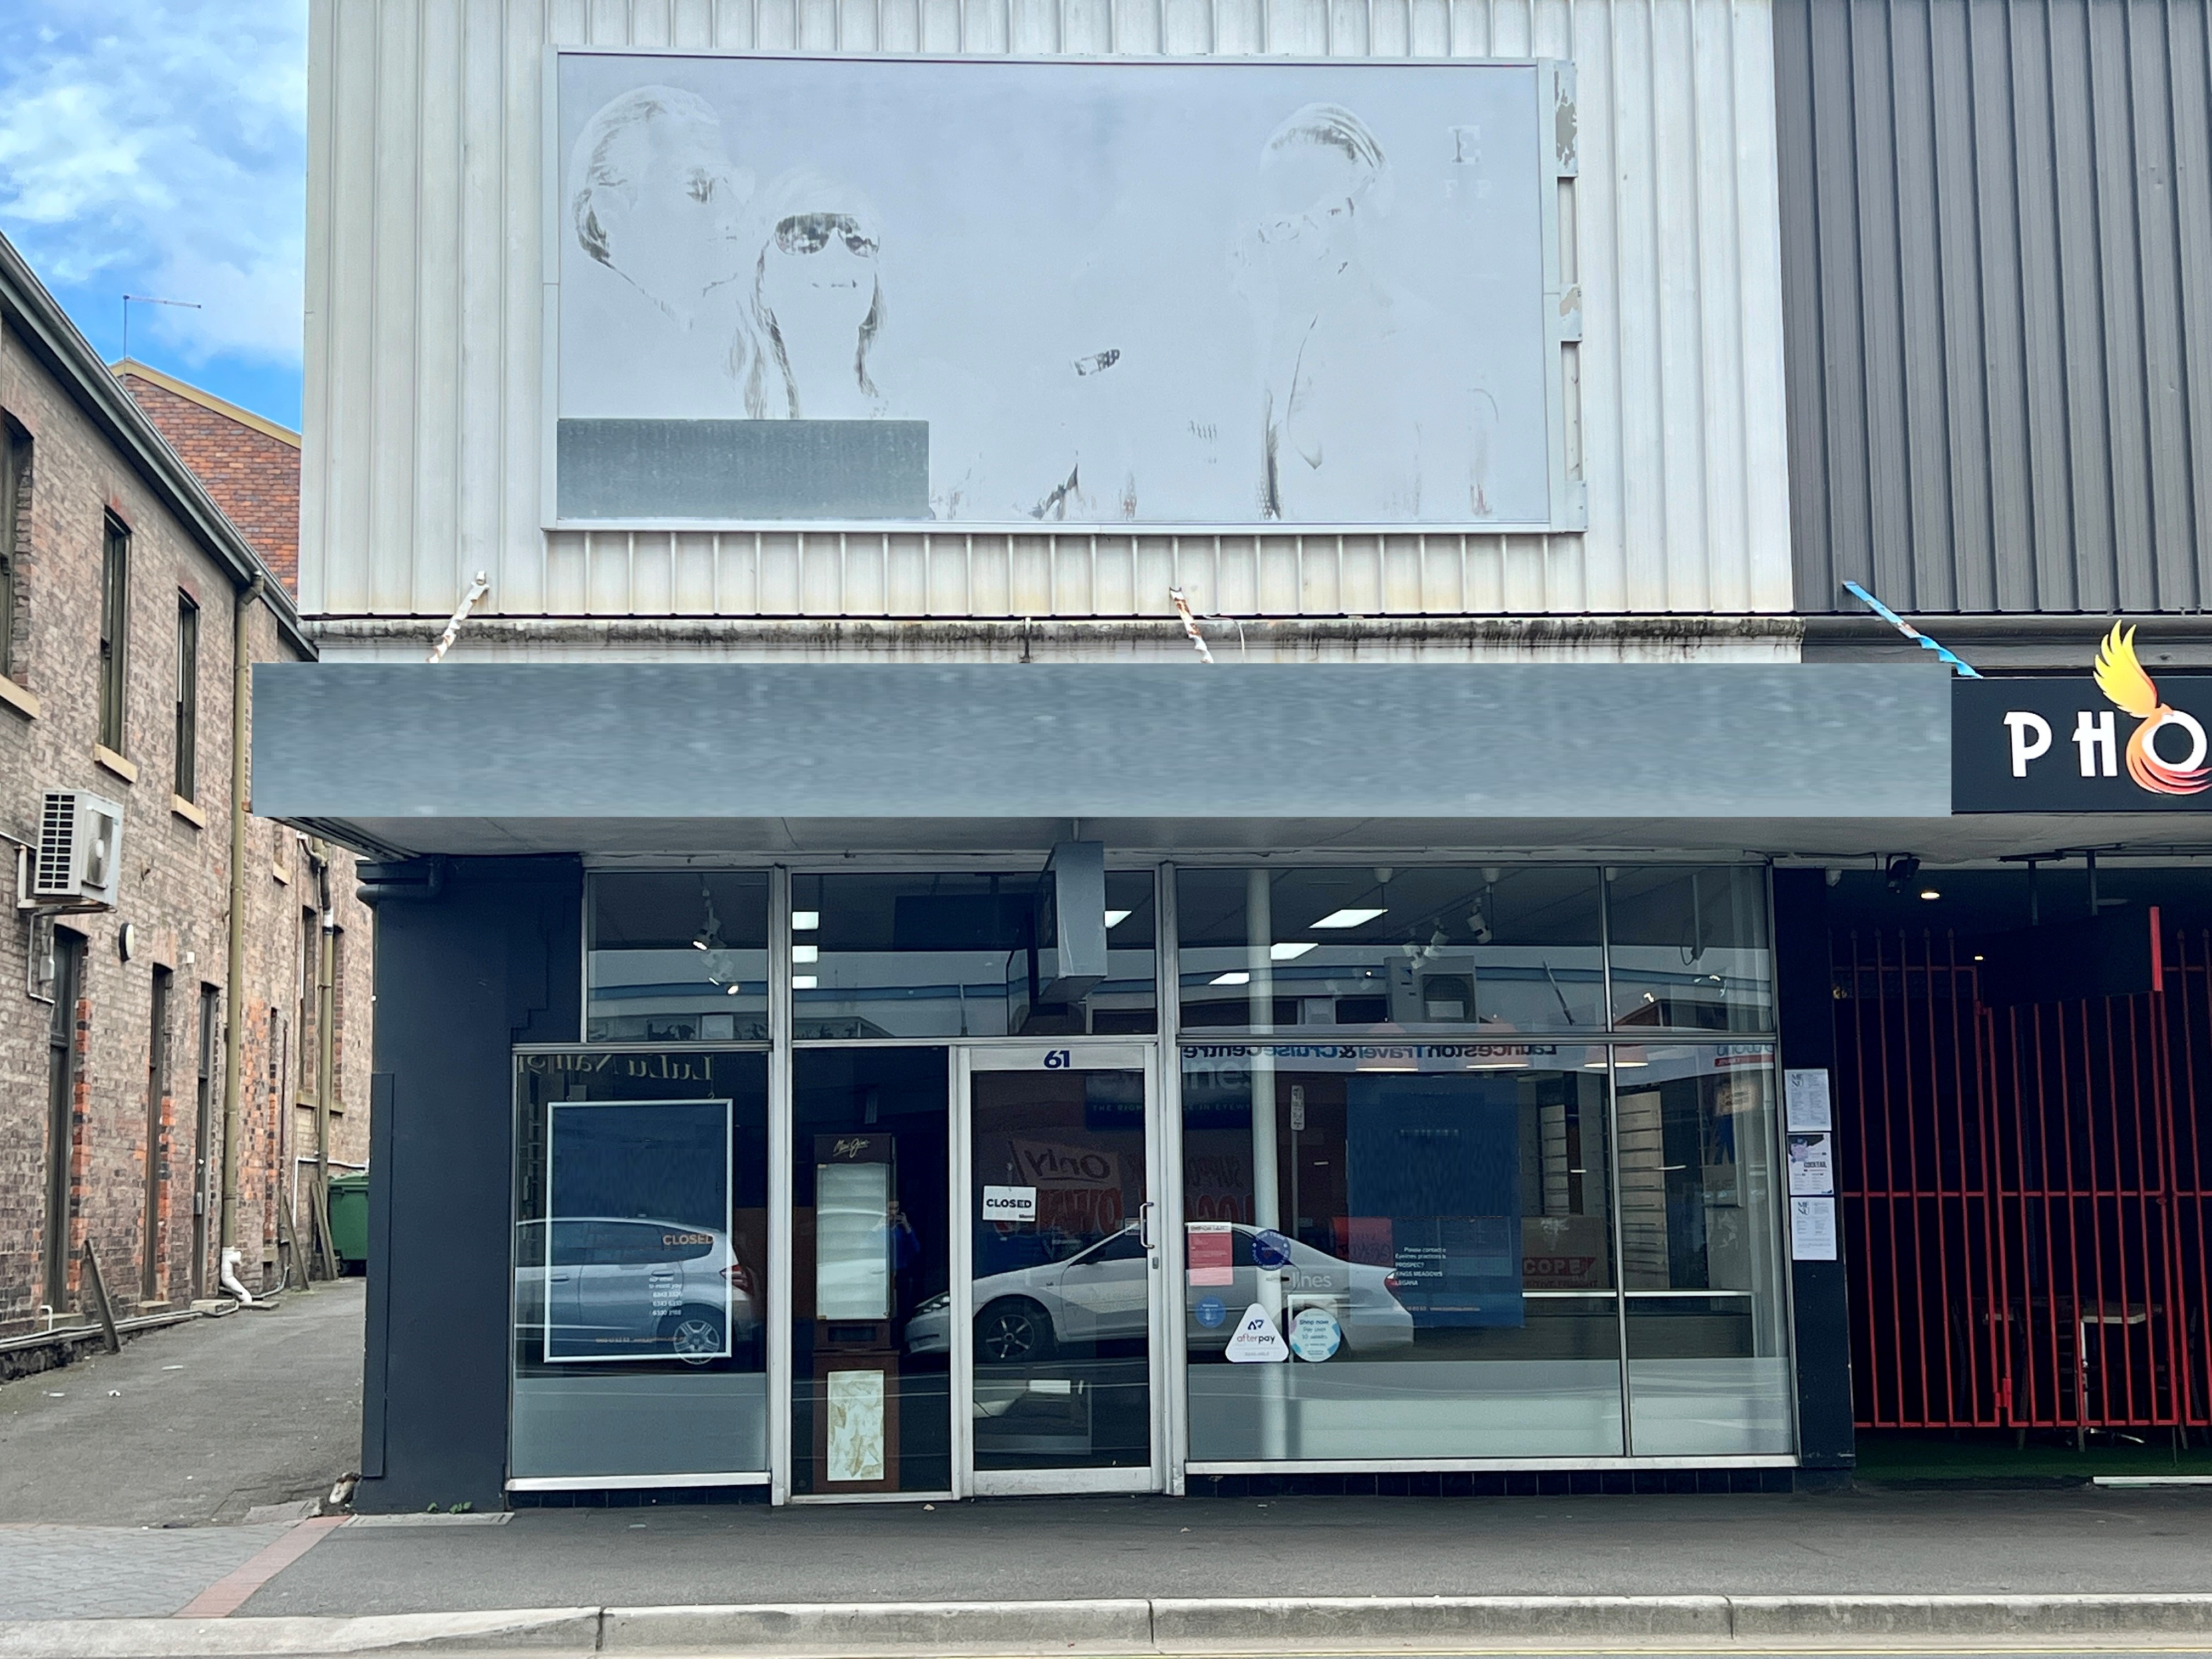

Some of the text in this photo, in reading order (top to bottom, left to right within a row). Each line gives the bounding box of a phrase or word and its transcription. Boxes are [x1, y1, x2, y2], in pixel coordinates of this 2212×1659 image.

[1043, 1050, 1070, 1068] 61
[986, 1199, 1032, 1208] CLOSED
[662, 1234, 714, 1245] CLOSED
[1237, 1333, 1276, 1345] afterpay
